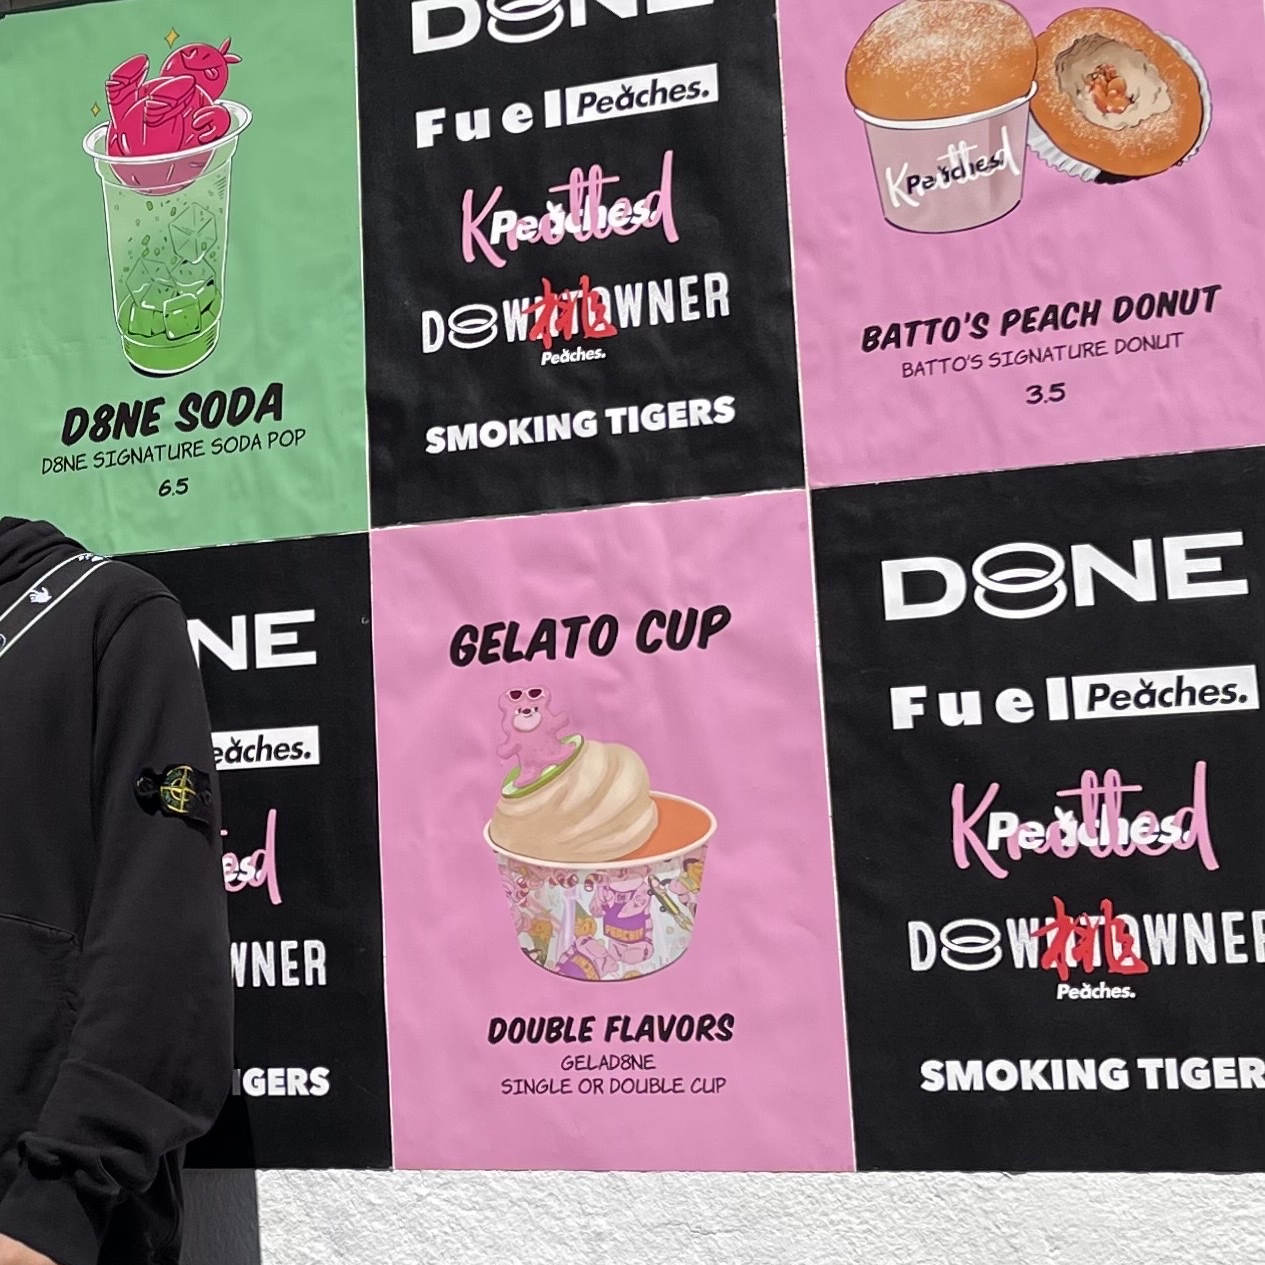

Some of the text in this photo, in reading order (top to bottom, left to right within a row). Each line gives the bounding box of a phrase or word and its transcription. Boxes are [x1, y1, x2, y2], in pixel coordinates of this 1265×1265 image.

[415, 87, 562, 149] Fuel
[861, 284, 1223, 354] BATTO'S PEACH DONUT
[902, 332, 1185, 379] BATTO'S SIGNATURE DONUT
[61, 382, 284, 446] D8NE SODA
[1025, 383, 1067, 405] 3.5
[425, 397, 735, 456] SMOKING TIGERS
[41, 427, 306, 476] D8NE SIGNATURE SODA POP
[157, 477, 189, 498] 6.5
[188, 609, 317, 670] NE
[449, 604, 732, 667] GELATO CUP
[890, 678, 1069, 730] Fuel
[212, 738, 311, 767] eaches.
[489, 1014, 735, 1043] DOUBLE FLAVORS
[232, 1067, 331, 1098] IGERS
[501, 1075, 727, 1096] SINGLE OR DOUBLE CUP
[560, 1054, 656, 1071] GELAD8NE
[920, 1057, 1265, 1092] SMOKING TIGER
